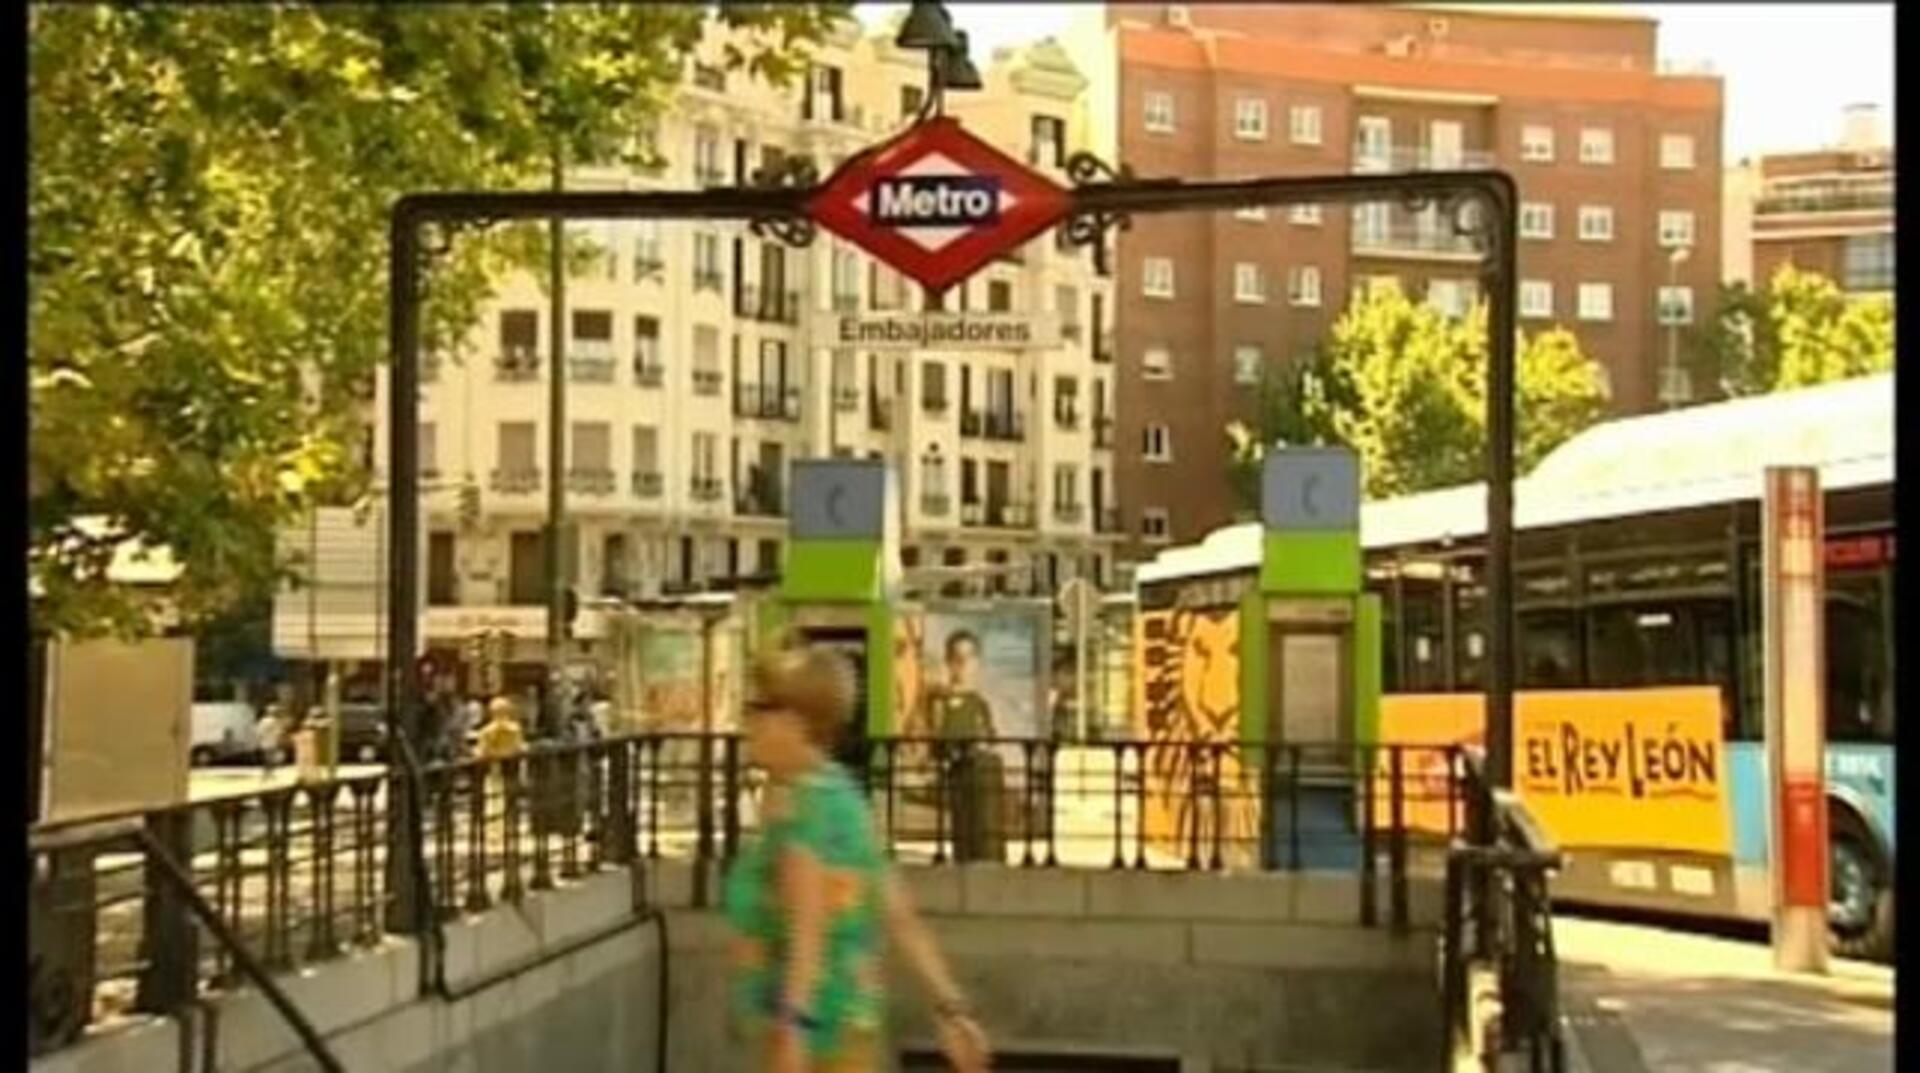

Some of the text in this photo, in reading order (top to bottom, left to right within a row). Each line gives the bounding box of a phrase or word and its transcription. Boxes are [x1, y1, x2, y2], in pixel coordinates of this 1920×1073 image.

[878, 182, 991, 217] Metro
[839, 318, 1030, 346] Embajadores
[1527, 721, 1717, 798] EL REY LEÓN
